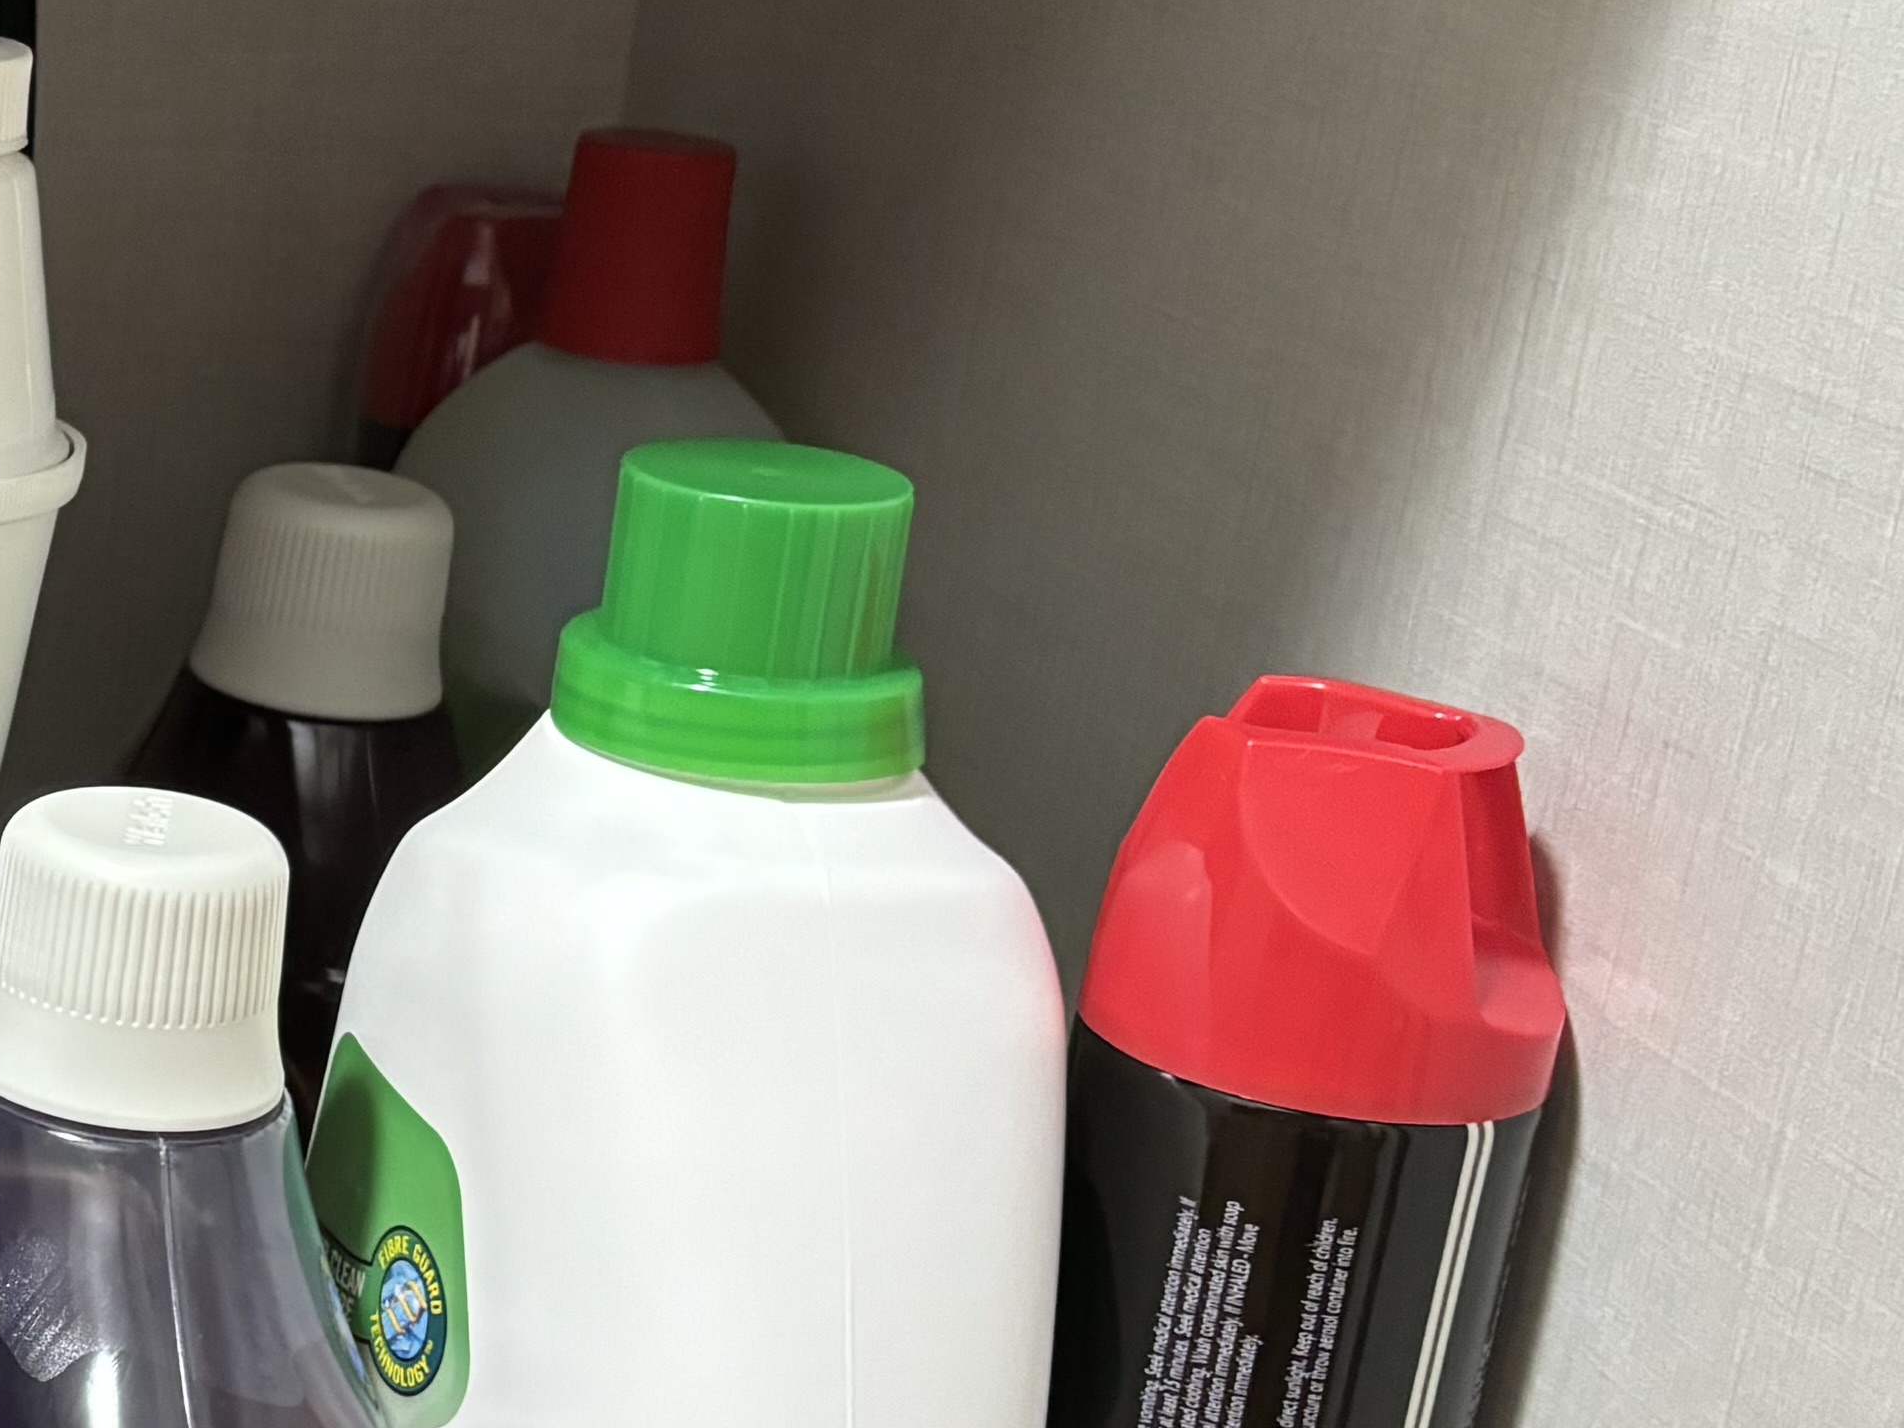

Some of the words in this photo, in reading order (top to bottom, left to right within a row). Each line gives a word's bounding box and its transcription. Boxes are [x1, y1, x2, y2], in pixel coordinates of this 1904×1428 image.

[378, 1235, 410, 1269] FIBRE
[413, 1244, 442, 1315] GUARD
[370, 1310, 430, 1388] TECHNOLOGY
